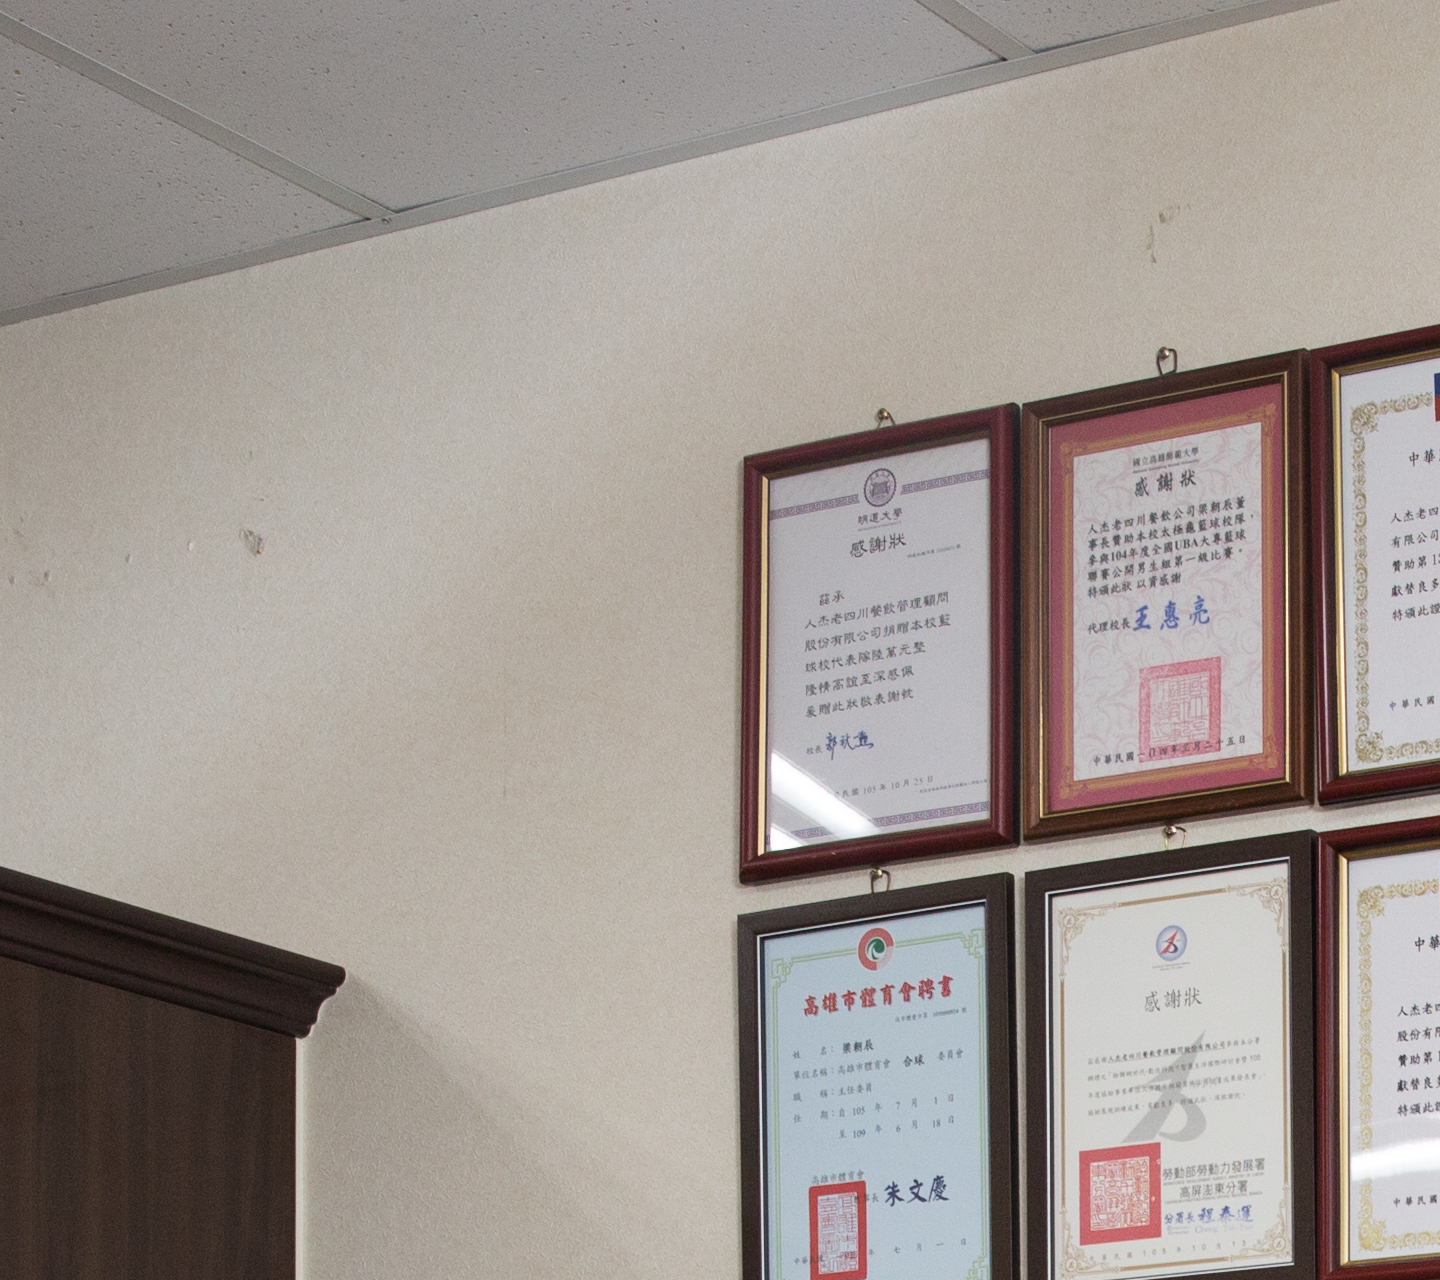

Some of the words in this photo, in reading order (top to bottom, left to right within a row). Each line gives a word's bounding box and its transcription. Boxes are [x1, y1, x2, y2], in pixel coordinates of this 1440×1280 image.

[1133, 447, 1199, 467] 國立高雄師範大學
[1134, 469, 1196, 497] 感謝狀
[858, 507, 902, 525] 明道大學
[1088, 496, 1245, 535] 人杰老四川餐飲公司梁朝辰董
[850, 533, 906, 558] 感謝狀
[1391, 529, 1439, 548] 有限公司
[805, 591, 949, 629] 人杰老四川餐飲管理顧問
[805, 641, 926, 673] 球校代表隊陸萬元整
[805, 665, 914, 697] 隆情高誼至深感佩
[805, 688, 914, 718] 爰贈此狀敬表謝忱
[803, 975, 954, 1017] 高雄市體育會聘書
[1144, 987, 1202, 1013] 感謝狀
[842, 1039, 874, 1055] 梁朝辰
[903, 1054, 925, 1067] 合球
[1163, 1158, 1265, 1181] 勞動部勞動力發展署
[1179, 1181, 1248, 1199] 高屏澎東分署
